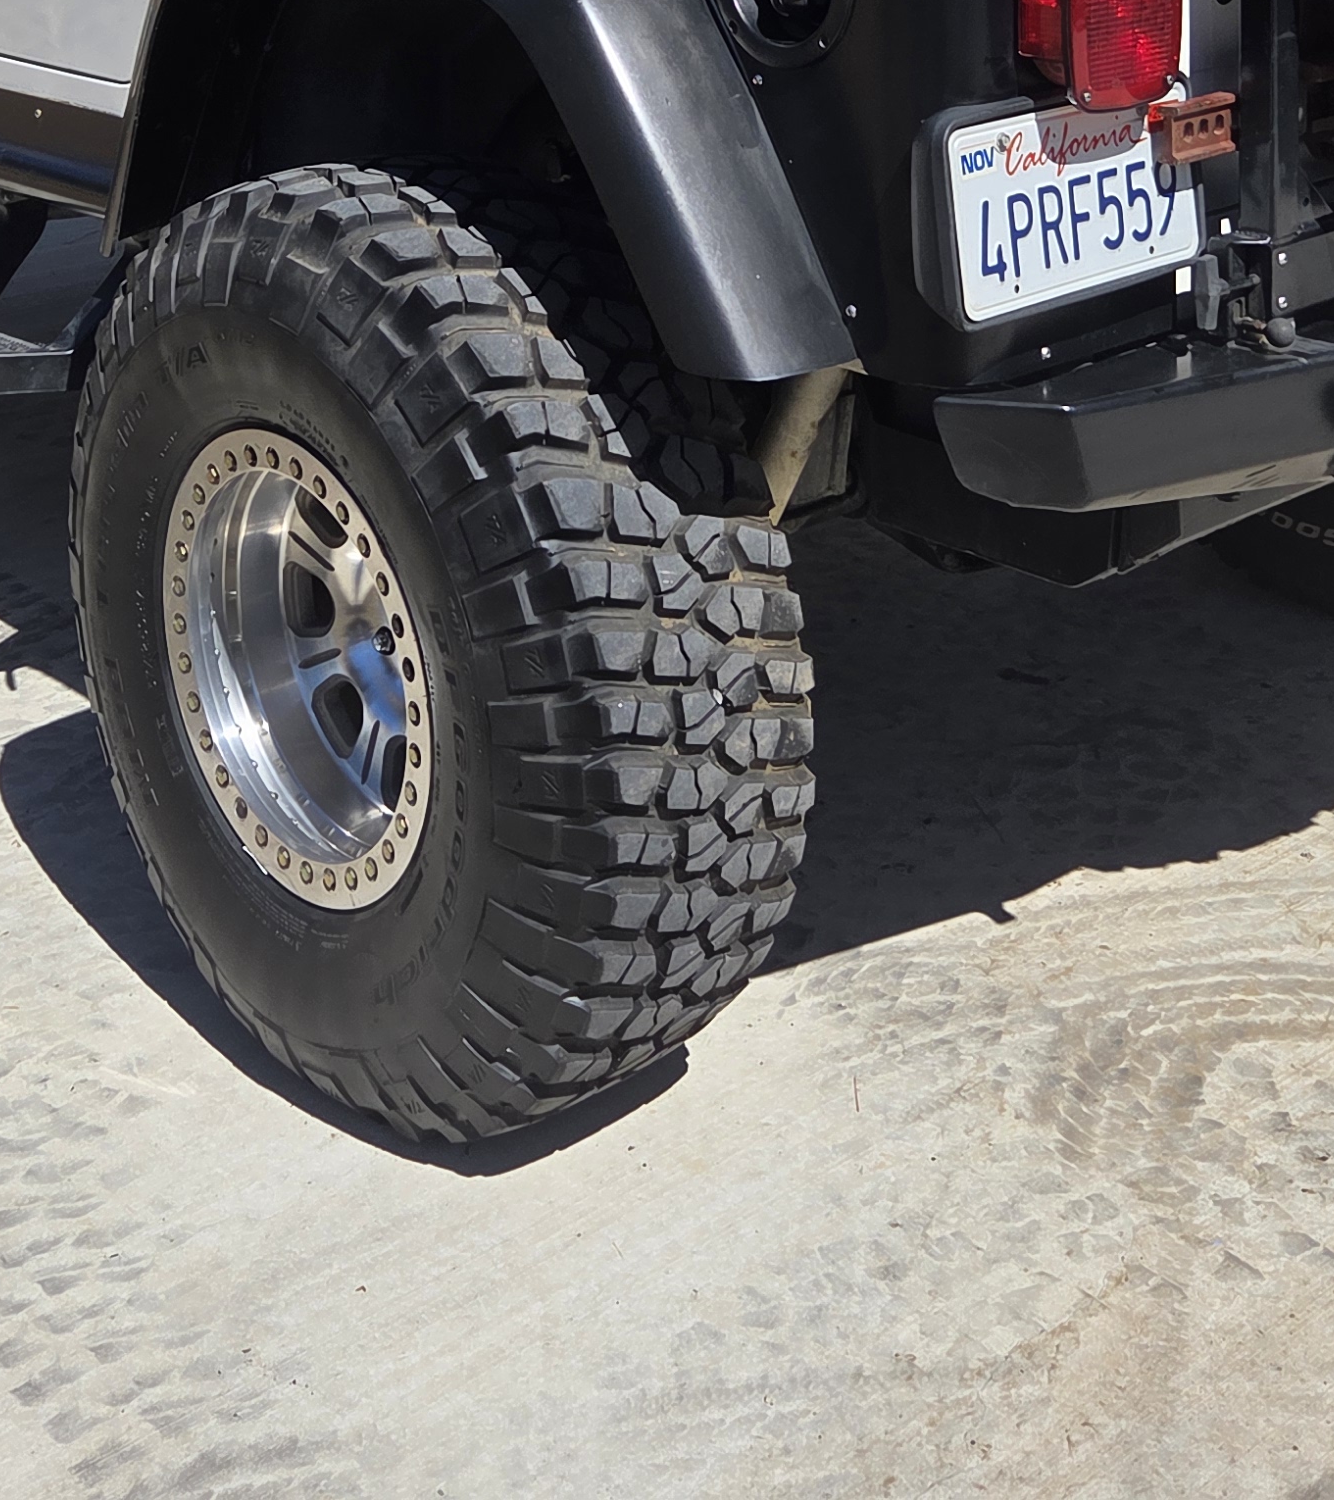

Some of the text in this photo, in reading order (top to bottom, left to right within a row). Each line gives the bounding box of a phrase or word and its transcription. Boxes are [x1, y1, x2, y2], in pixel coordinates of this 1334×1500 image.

[960, 148, 994, 176] NOV
[1004, 114, 1147, 177] California
[980, 160, 1178, 283] 4PRF559
[156, 341, 212, 385] T/A
